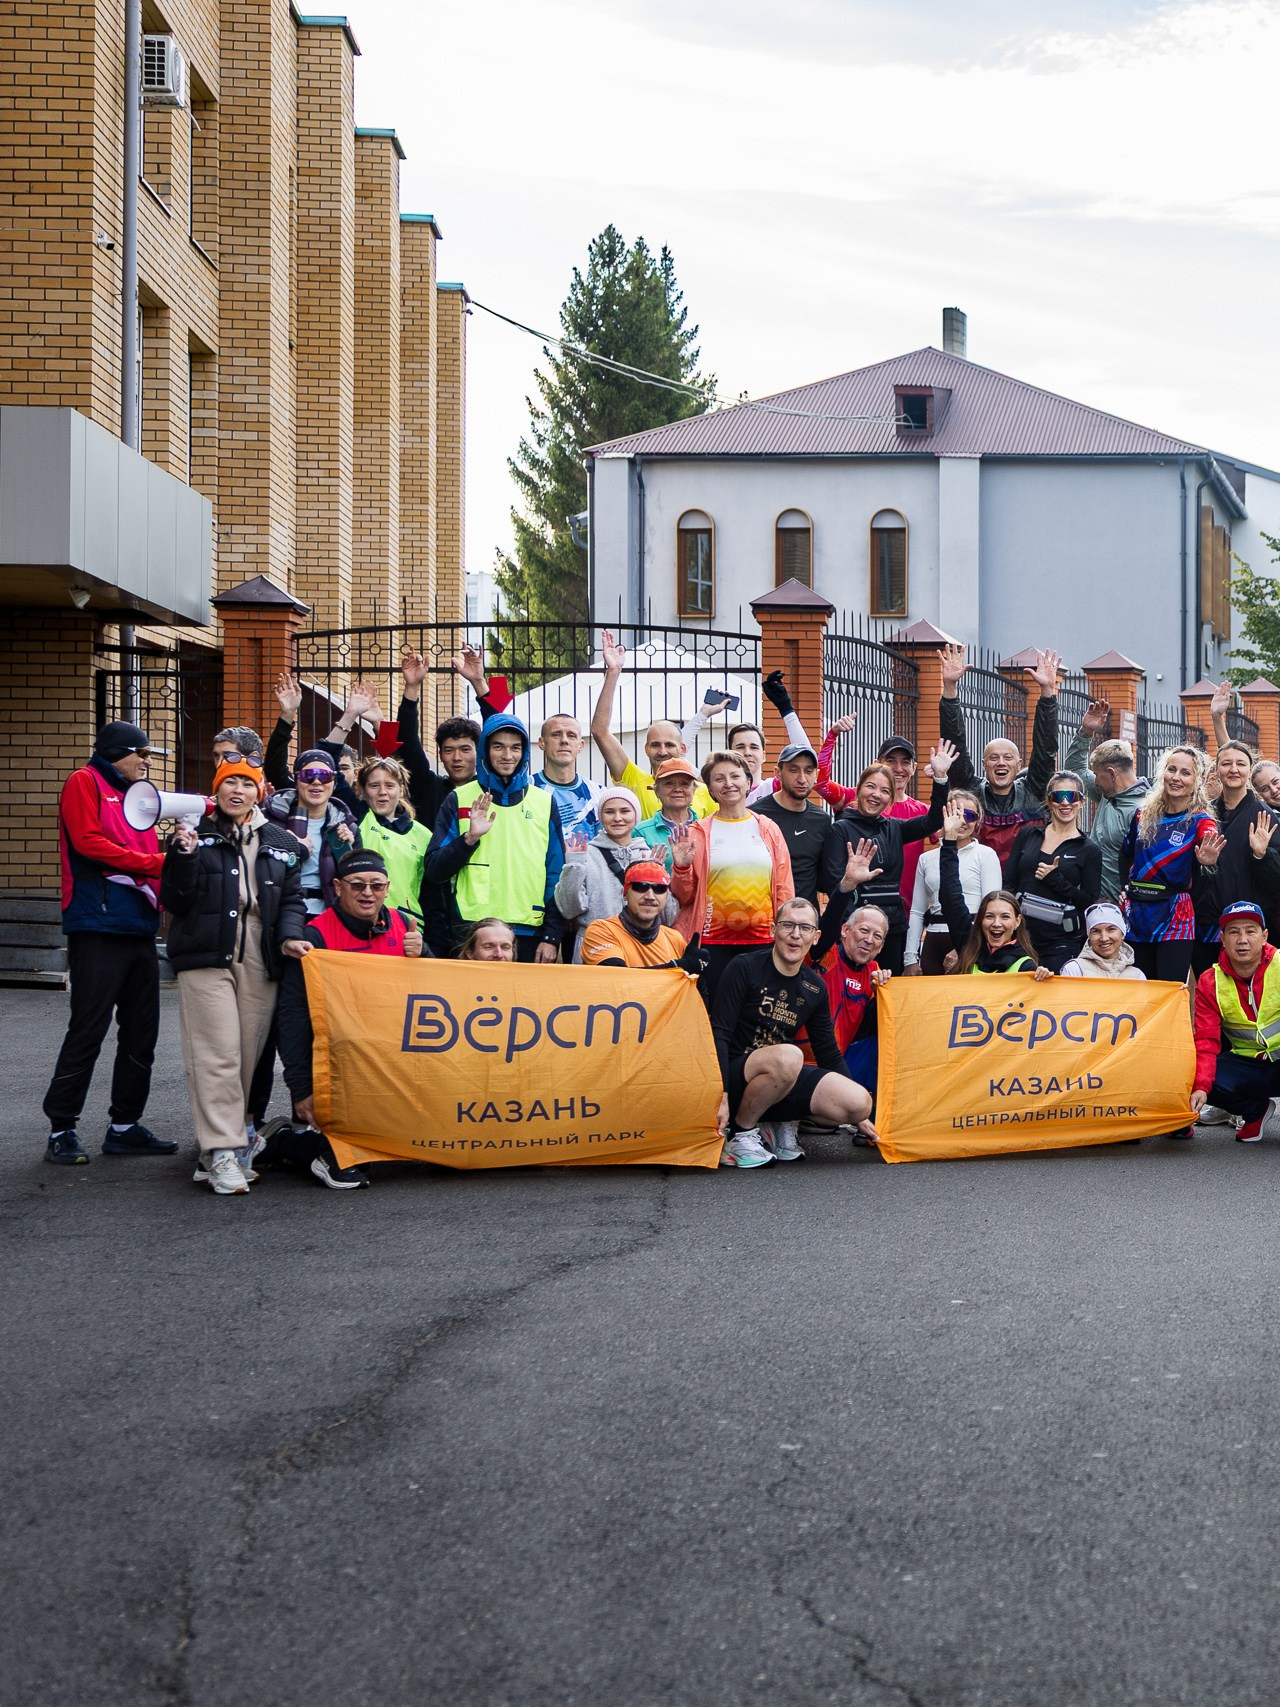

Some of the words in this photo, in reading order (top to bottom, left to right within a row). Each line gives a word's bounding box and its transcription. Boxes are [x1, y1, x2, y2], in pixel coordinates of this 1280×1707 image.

[702, 901, 715, 937] МОСКВА
[773, 1006, 798, 1020] MONTH
[775, 1000, 789, 1009] DAY
[401, 993, 648, 1064] Вёрст
[771, 1012, 798, 1027] EDITION
[948, 1002, 1138, 1050] Вёрст
[989, 1073, 1103, 1097] КАЗАНЬ
[456, 1095, 601, 1123] КАЗАНЬ
[952, 1105, 1086, 1129] ЦЕНТРАЛЬНЫЙ
[1093, 1105, 1138, 1118] ПАРК
[411, 1132, 579, 1150] ЦЕНТРАЛЬНЫЙ
[587, 1129, 646, 1143] ПАРК
